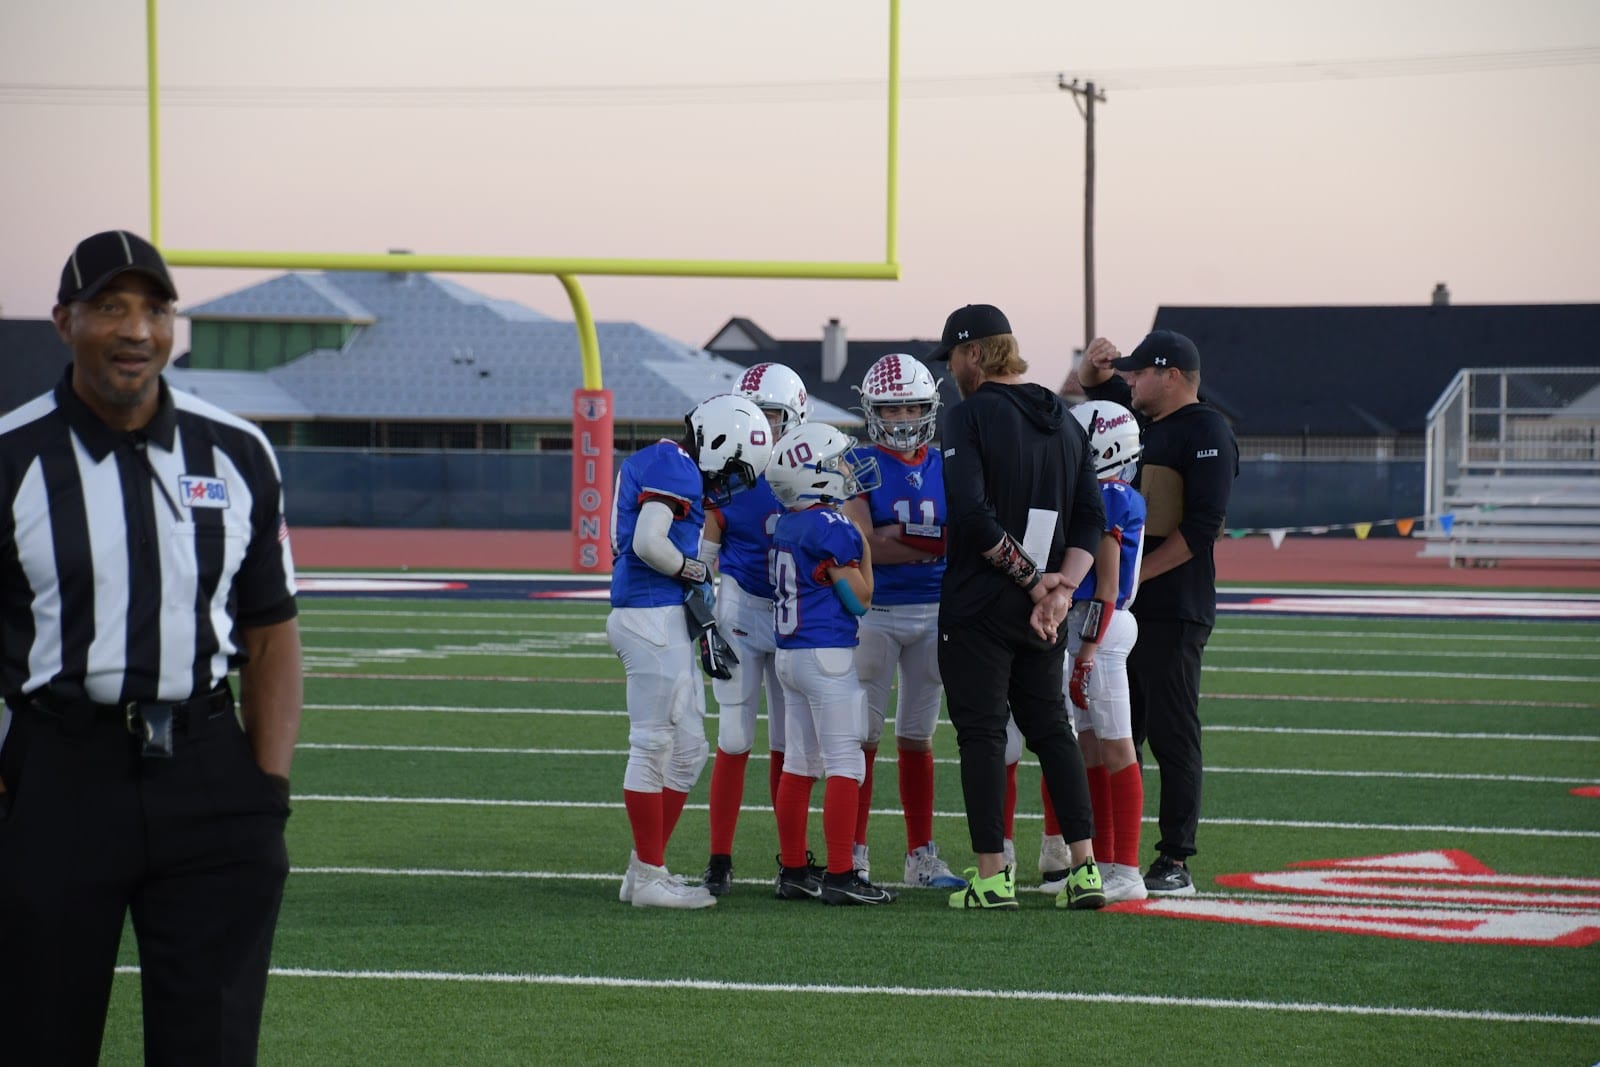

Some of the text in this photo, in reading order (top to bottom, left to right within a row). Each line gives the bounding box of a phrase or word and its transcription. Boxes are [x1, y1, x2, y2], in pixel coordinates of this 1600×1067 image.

[786, 442, 813, 468] 10
[579, 431, 601, 568] LIONS
[893, 500, 935, 526] 11
[773, 549, 798, 635] 0
